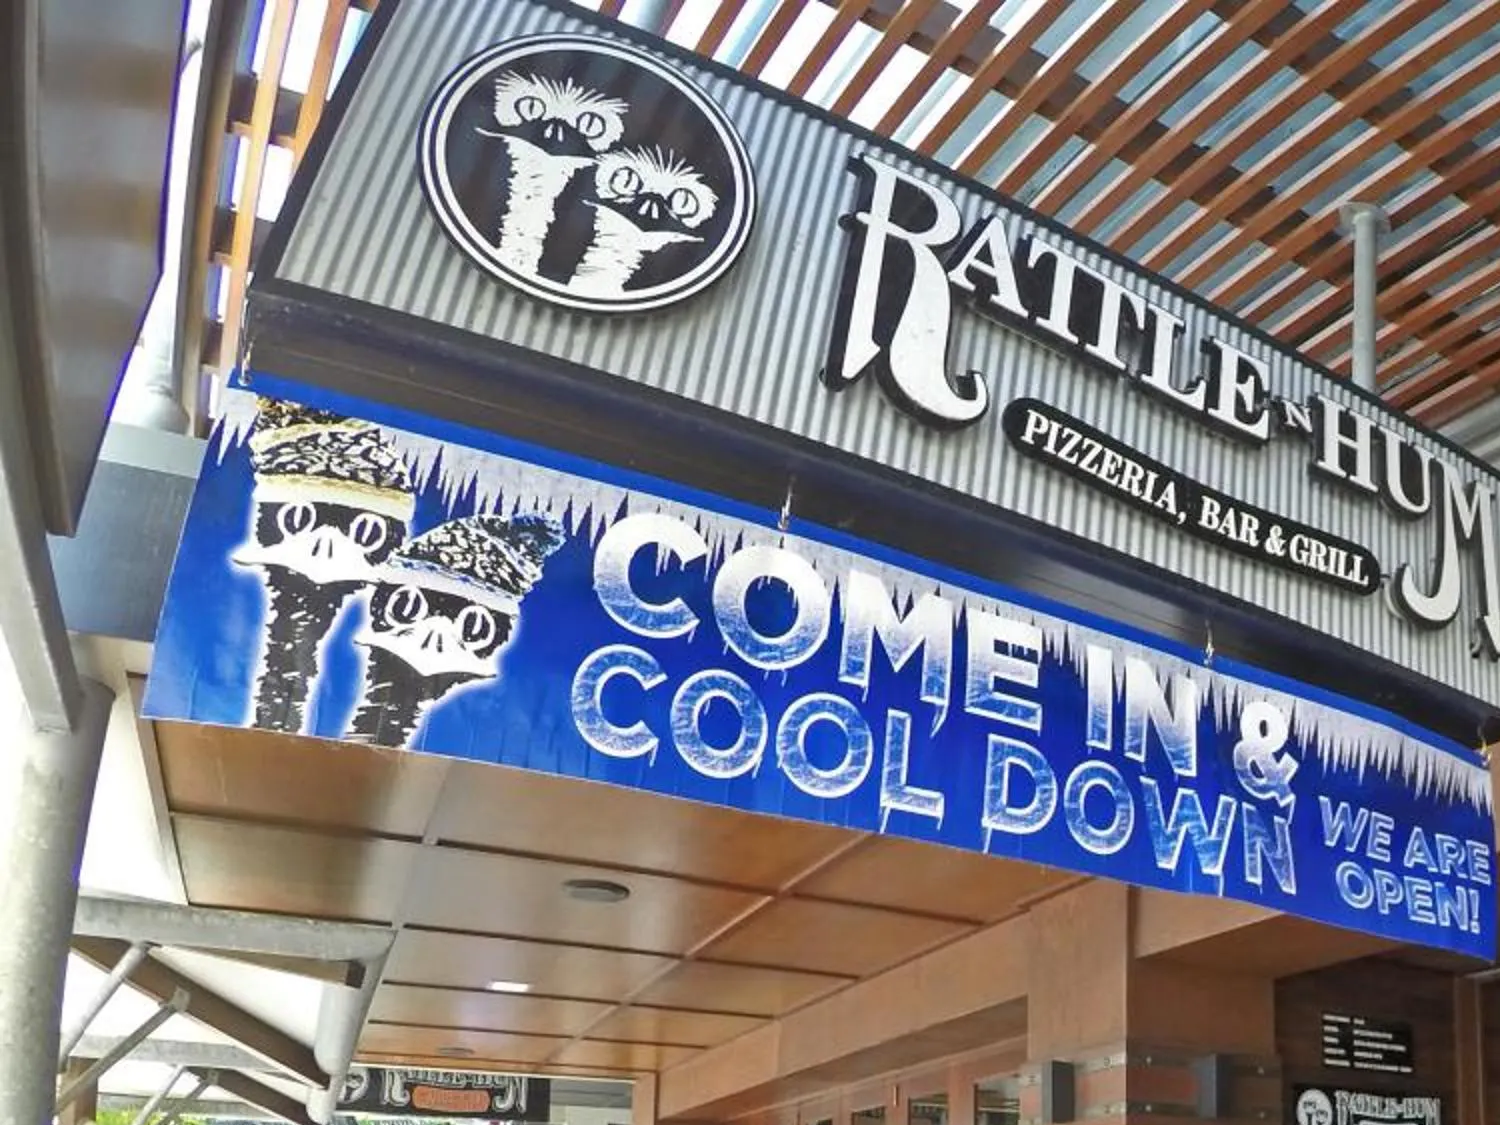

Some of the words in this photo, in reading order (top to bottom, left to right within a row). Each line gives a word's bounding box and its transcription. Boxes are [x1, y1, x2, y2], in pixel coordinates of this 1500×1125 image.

[838, 153, 1271, 441] RATTLE
[1021, 407, 1188, 526] PIZZERIA,
[1198, 494, 1260, 546] BAR
[1265, 524, 1287, 557] &
[1288, 532, 1371, 587] GRILL
[571, 643, 945, 824] COOL
[982, 733, 1297, 896] DOWN
[1318, 796, 1395, 861] WE
[1403, 827, 1492, 886] ARE
[593, 512, 1043, 733] COME
[1085, 644, 1197, 778] IN
[1233, 701, 1298, 807] &
[1336, 861, 1482, 934] OPEN!
